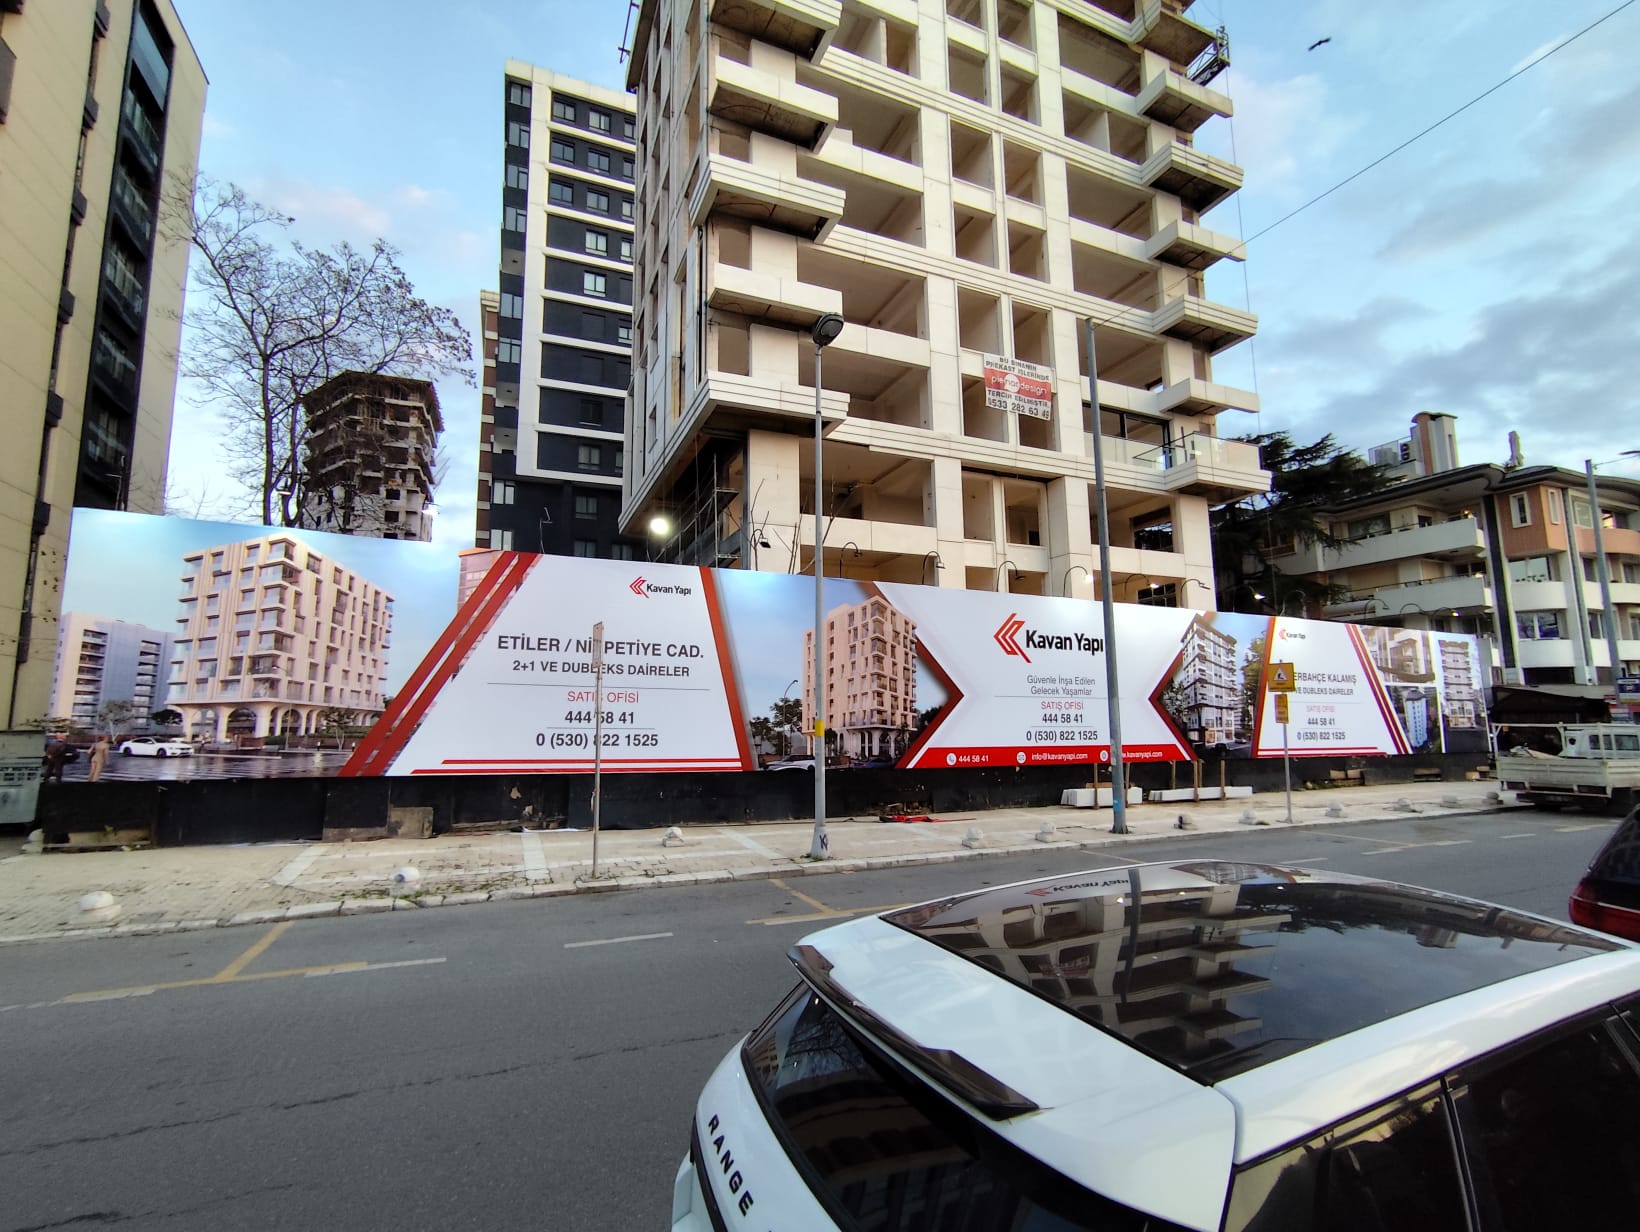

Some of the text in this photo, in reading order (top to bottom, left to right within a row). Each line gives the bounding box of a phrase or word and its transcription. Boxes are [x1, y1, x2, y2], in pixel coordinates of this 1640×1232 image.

[1011, 402, 1026, 413] 282
[646, 583, 692, 597] Kavan Yapı
[497, 633, 561, 652] ETİLER
[575, 636, 662, 656] NİPETİYE
[666, 644, 704, 659] CAD.
[1026, 630, 1104, 656] Kavan Yapı
[512, 660, 536, 672] 2+1
[540, 661, 557, 673] VE
[628, 663, 690, 677] DAİRELER
[1026, 674, 1096, 686] Güvenle İnşa Edilen
[1293, 672, 1326, 684] ERBAHÇE
[567, 690, 639, 703] SATI OFİSİ
[1030, 685, 1092, 698] Gelecek Yaşamlar
[1040, 700, 1084, 711] SATIŞ OFİSİ
[564, 711, 592, 724] 444
[618, 711, 634, 724] 41
[1042, 713, 1083, 723] 444 58 41
[536, 734, 545, 746] 0
[550, 733, 589, 750] (530)
[625, 734, 658, 747] 1525
[1026, 730, 1098, 743] 0 (530) 822 1525
[958, 755, 970, 763] 444
[981, 754, 989, 762] 41
[1121, 750, 1163, 759] w.kavanyapi.com
[708, 1113, 754, 1217] RANGE
